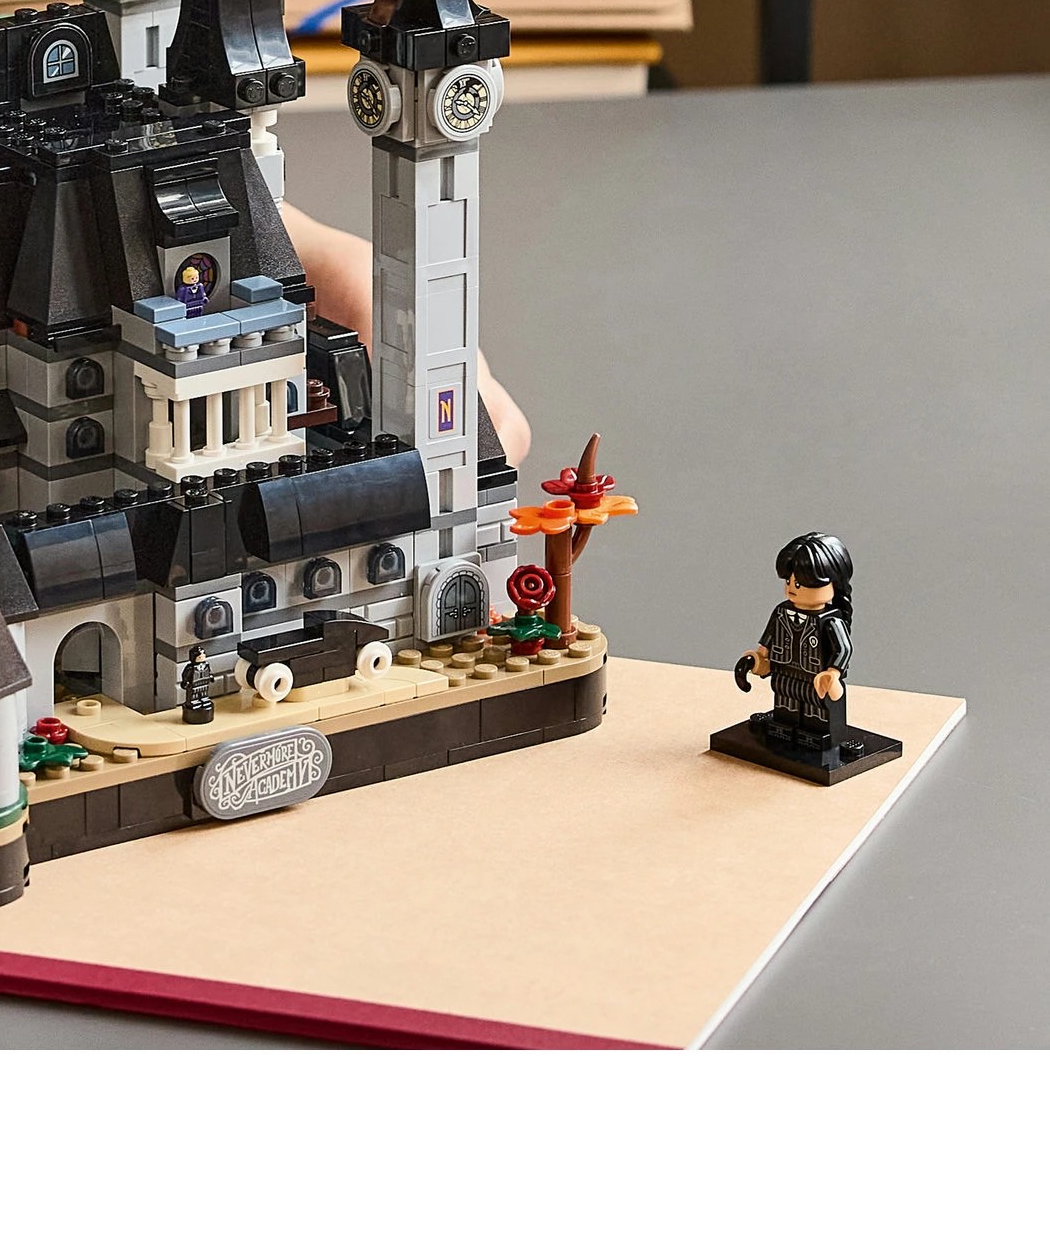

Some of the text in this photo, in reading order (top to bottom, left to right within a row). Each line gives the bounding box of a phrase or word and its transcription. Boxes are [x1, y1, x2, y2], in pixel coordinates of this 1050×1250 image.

[440, 399, 451, 423] N
[221, 740, 297, 797] NEVERMORE
[243, 757, 313, 805] ACADEMY
